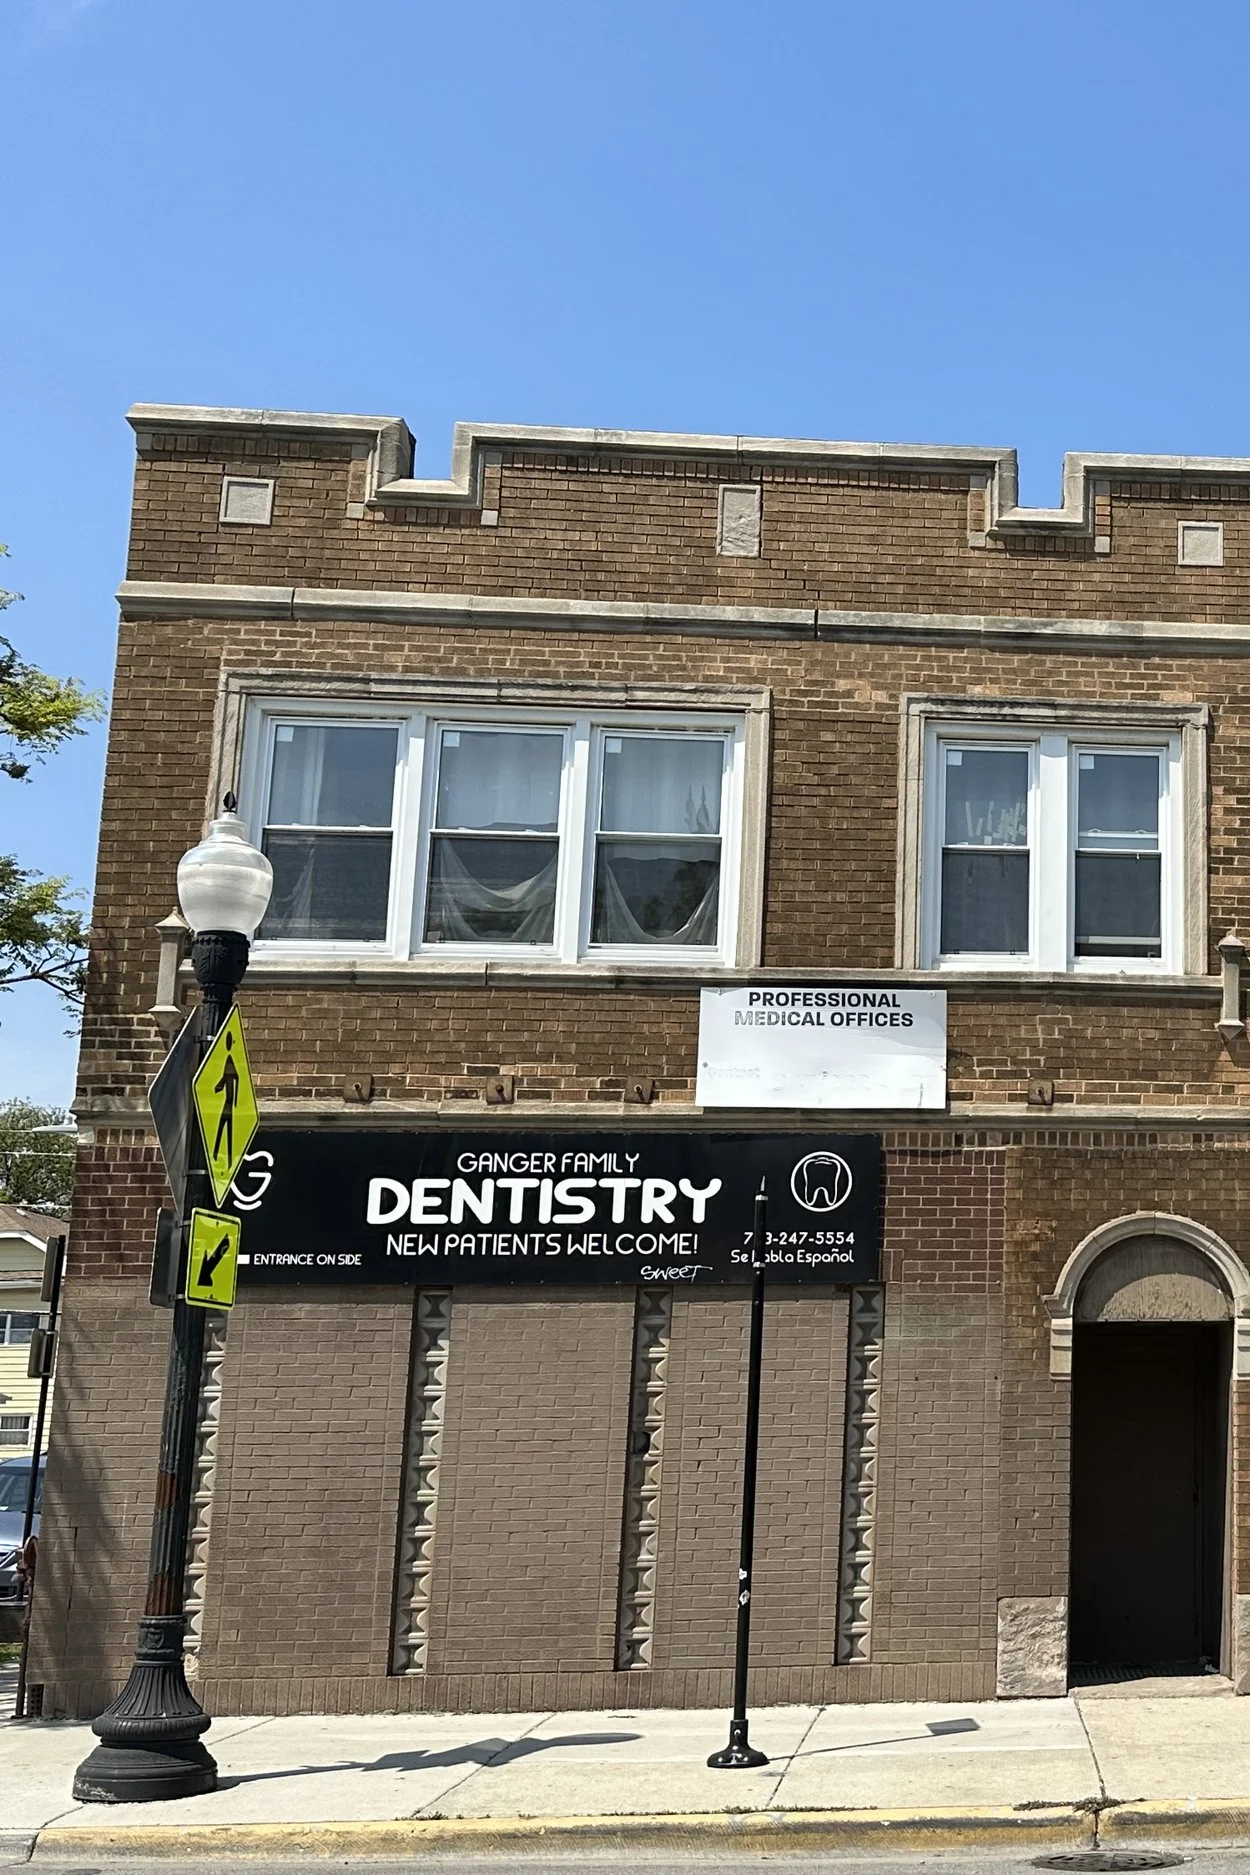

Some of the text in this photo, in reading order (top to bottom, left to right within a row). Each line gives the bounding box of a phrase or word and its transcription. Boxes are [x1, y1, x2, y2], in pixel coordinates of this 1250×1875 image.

[748, 991, 901, 1008] PROFESSIONAL
[734, 1010, 914, 1028] MEDICAL OFFICES
[456, 1152, 640, 1173] GANGER FAMILY
[366, 1177, 723, 1225] DENTISTRY
[387, 1232, 698, 1256] NEW PATIENTS WELCOME!
[743, 1231, 855, 1245] 73-247-5554
[253, 1253, 363, 1266] ENTRANCE ON SIDE
[730, 1249, 749, 1263] Se
[796, 1247, 855, 1268] Español
